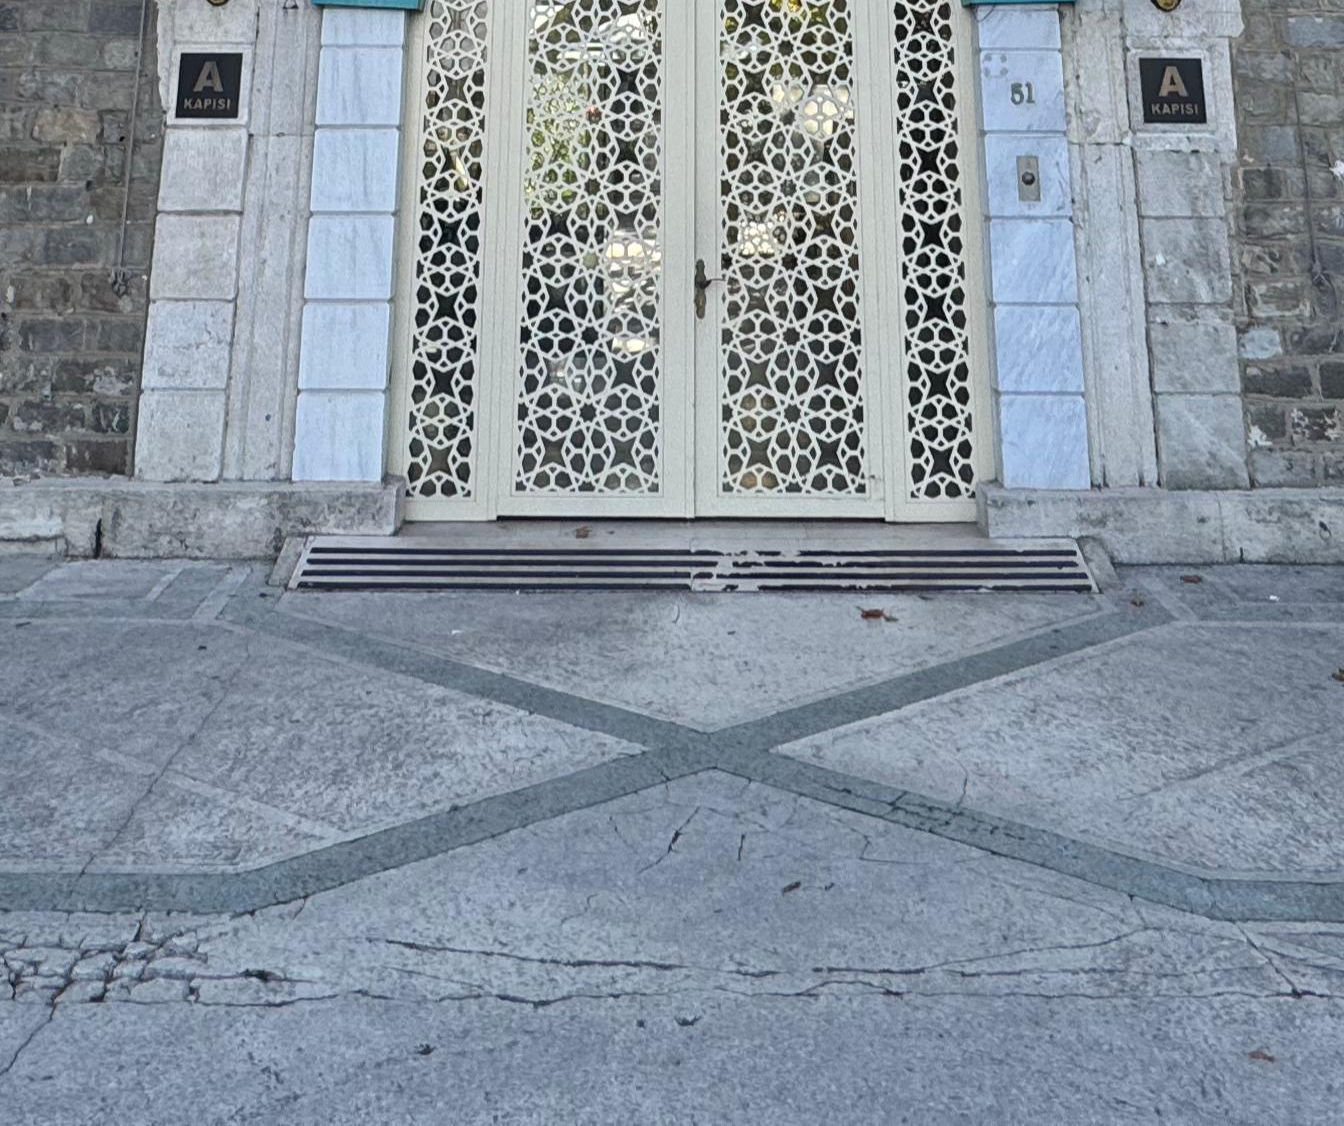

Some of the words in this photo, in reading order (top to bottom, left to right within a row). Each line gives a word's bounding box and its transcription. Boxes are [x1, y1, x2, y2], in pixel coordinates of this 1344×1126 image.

[192, 60, 224, 92] A
[1158, 65, 1189, 97] A
[183, 97, 231, 110] KAPISI
[1010, 81, 1035, 105] 51
[1151, 103, 1199, 115] KAPISI
